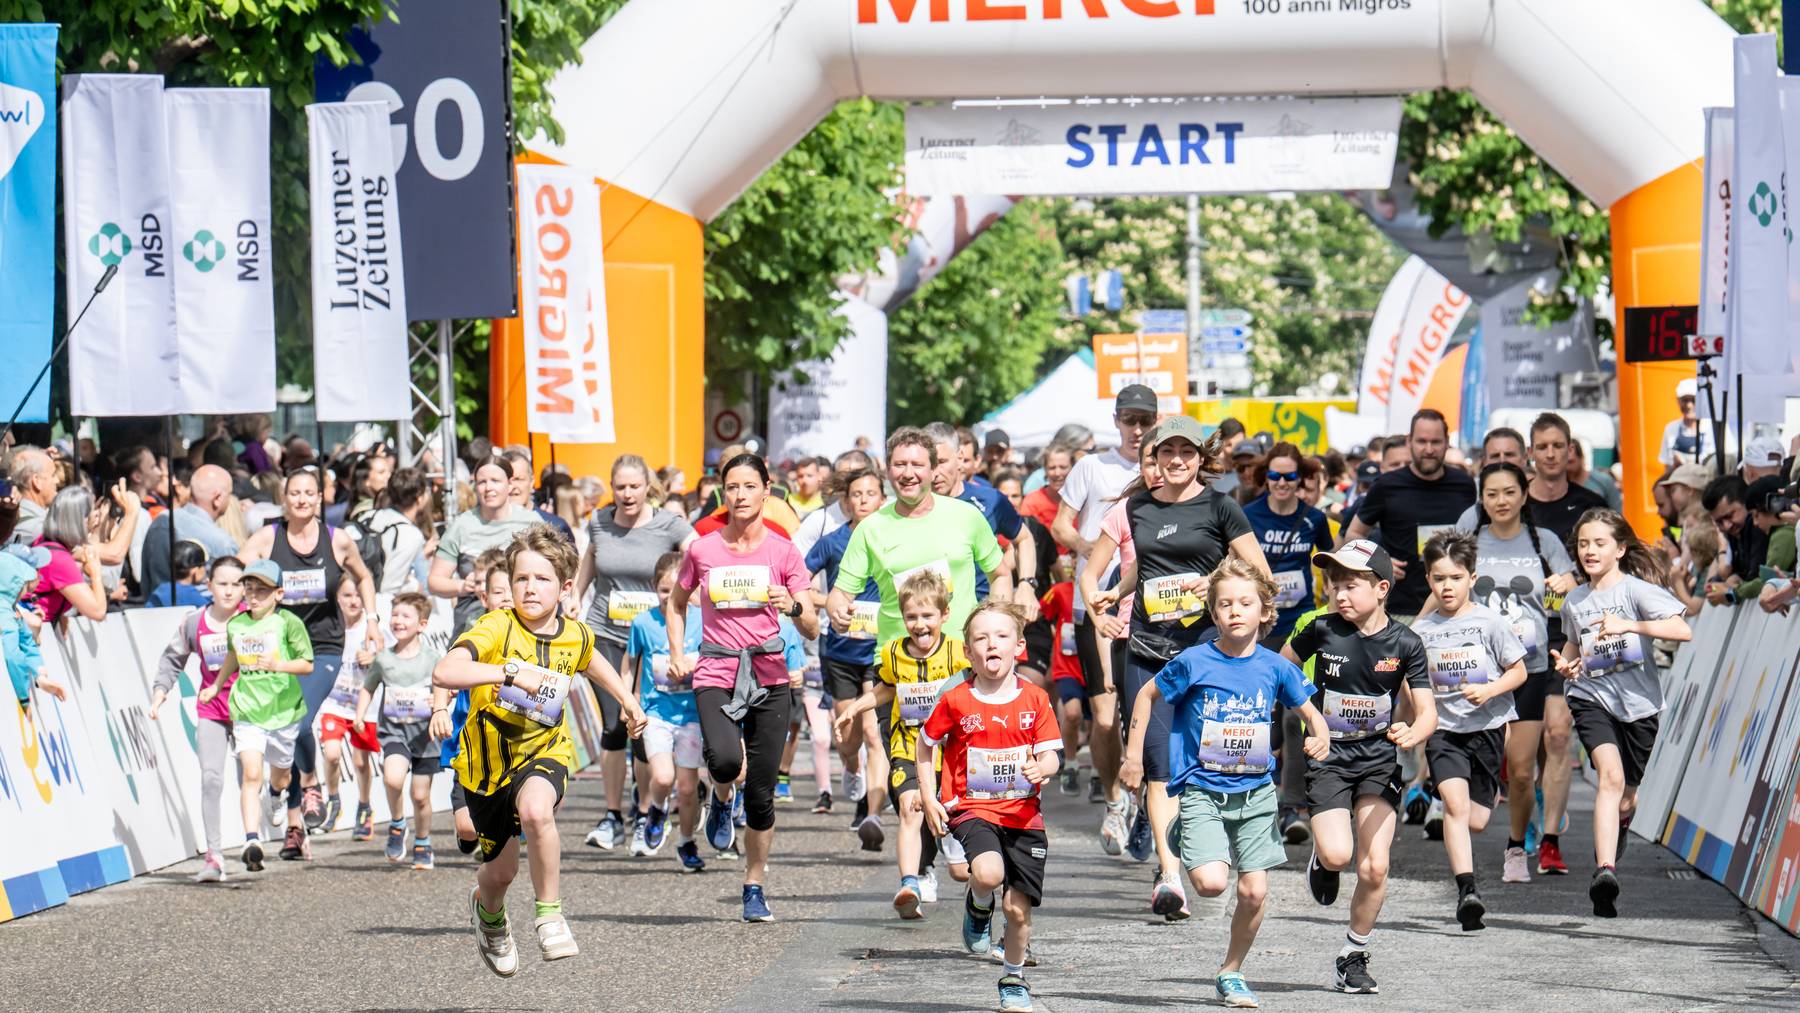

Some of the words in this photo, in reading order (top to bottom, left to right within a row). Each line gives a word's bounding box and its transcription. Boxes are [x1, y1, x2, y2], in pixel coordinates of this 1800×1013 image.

[1066, 123, 1244, 168] START
[331, 150, 361, 313] Luzerner
[141, 213, 165, 278] MSD
[363, 174, 390, 311] Zeitung
[237, 219, 259, 281] MSD
[1156, 523, 1178, 539] RUN
[1290, 543, 1311, 552] FIRST
[723, 578, 756, 588] ELIANE
[1158, 578, 1185, 589] MERCI
[1159, 588, 1186, 599] EDITH
[241, 643, 265, 653] NICO
[1593, 640, 1628, 655] SOPHIE
[1322, 652, 1343, 661] CRAFT
[1441, 651, 1469, 659] MERCI
[557, 660, 572, 675] BVB
[1325, 663, 1341, 677] JK
[1437, 660, 1478, 671] NICOLAS
[1341, 698, 1375, 708] MERCI
[1339, 708, 1376, 718] JONAS
[1222, 728, 1255, 737] MERCI
[1223, 739, 1253, 749] LEAN
[987, 752, 1020, 762] MERCI
[993, 764, 1016, 775] BEN
